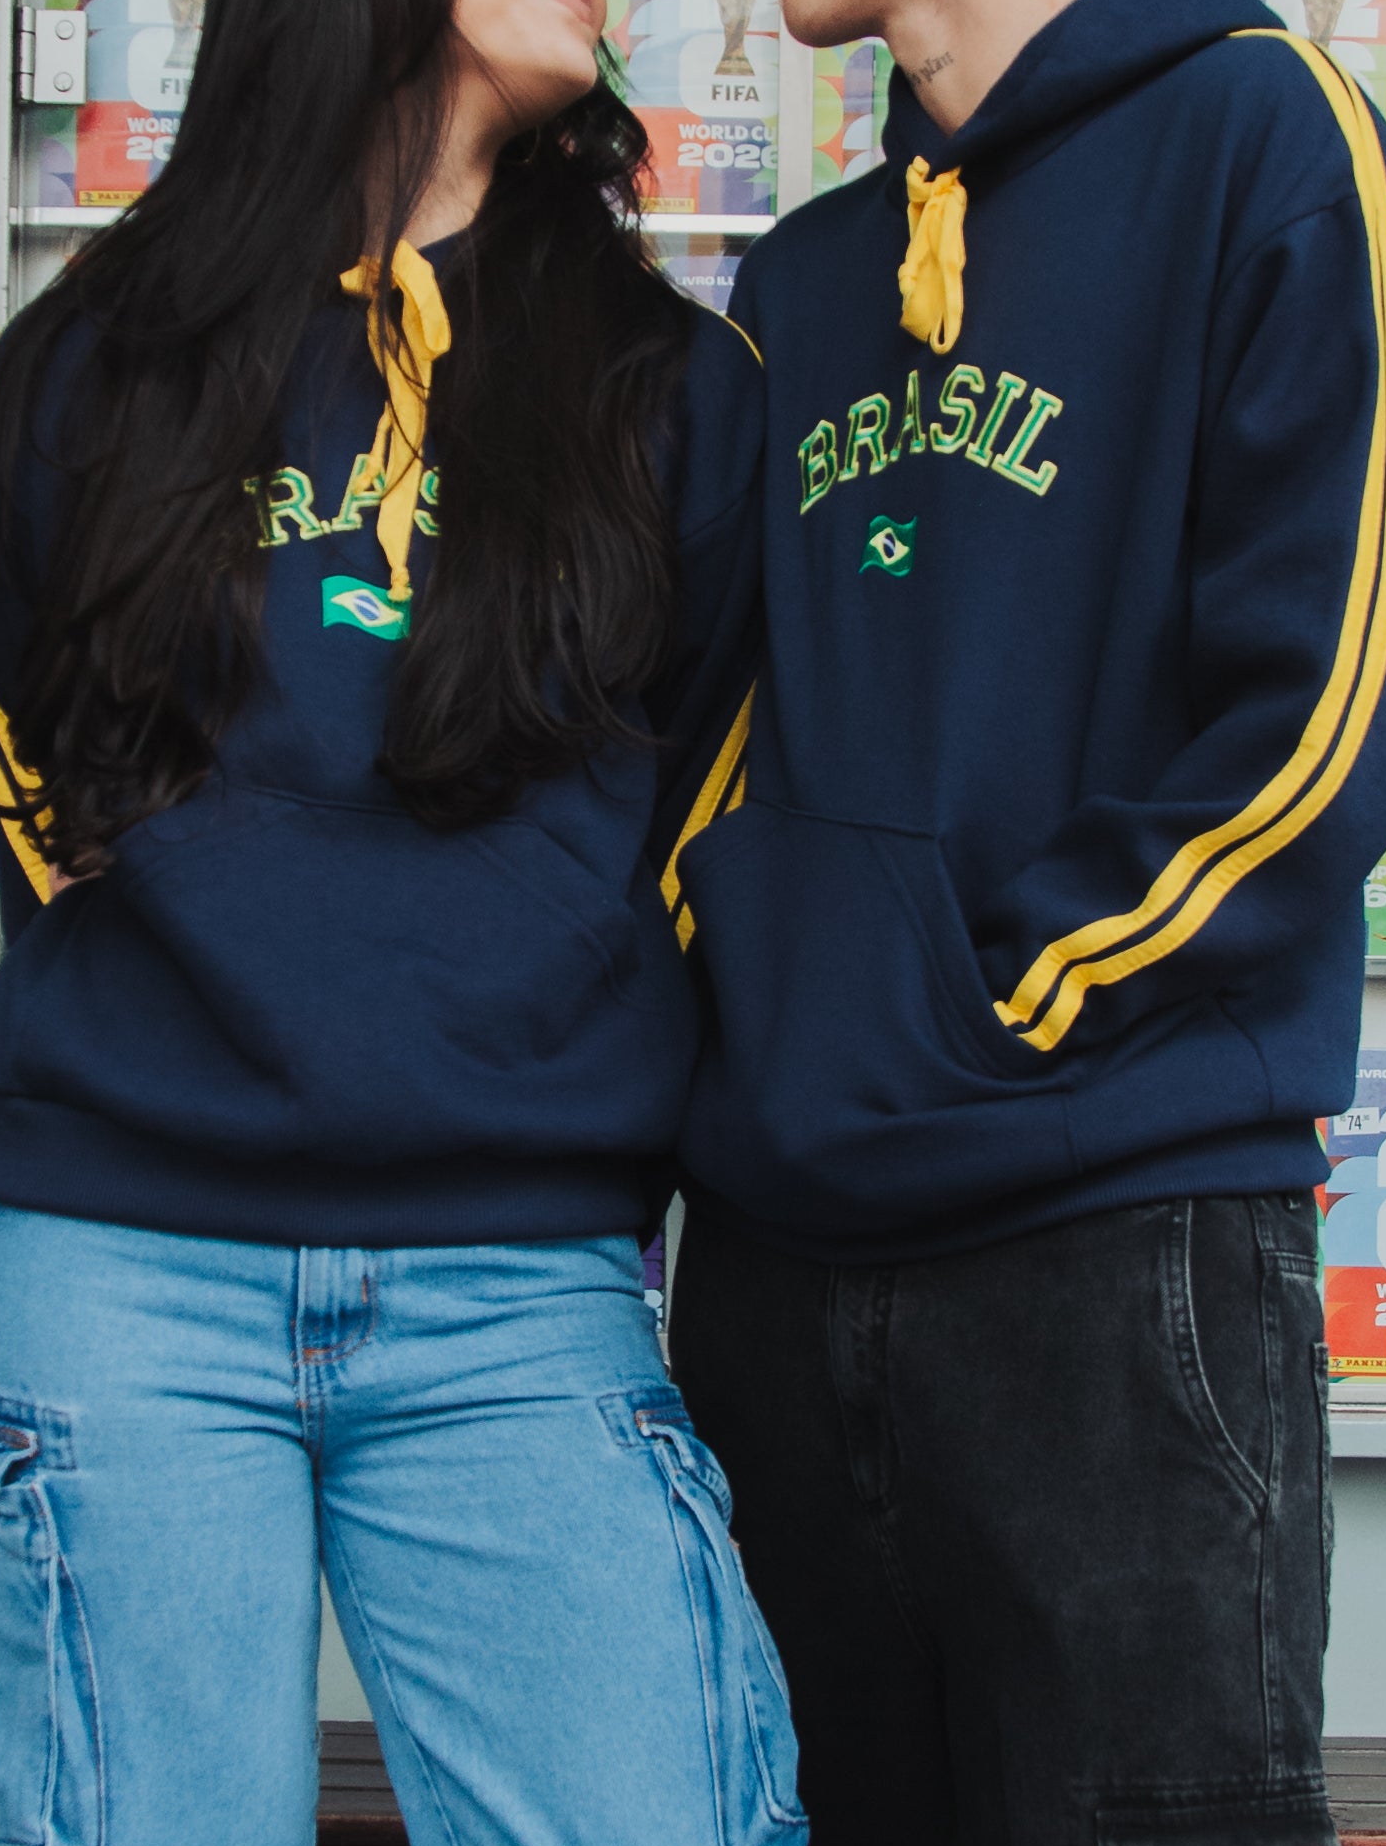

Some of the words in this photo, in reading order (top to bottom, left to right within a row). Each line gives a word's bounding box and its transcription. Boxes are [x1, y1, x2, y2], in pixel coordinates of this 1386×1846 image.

[710, 83, 761, 103] FIFA
[678, 123, 749, 141] WORLD
[796, 364, 1065, 517] BRASIL
